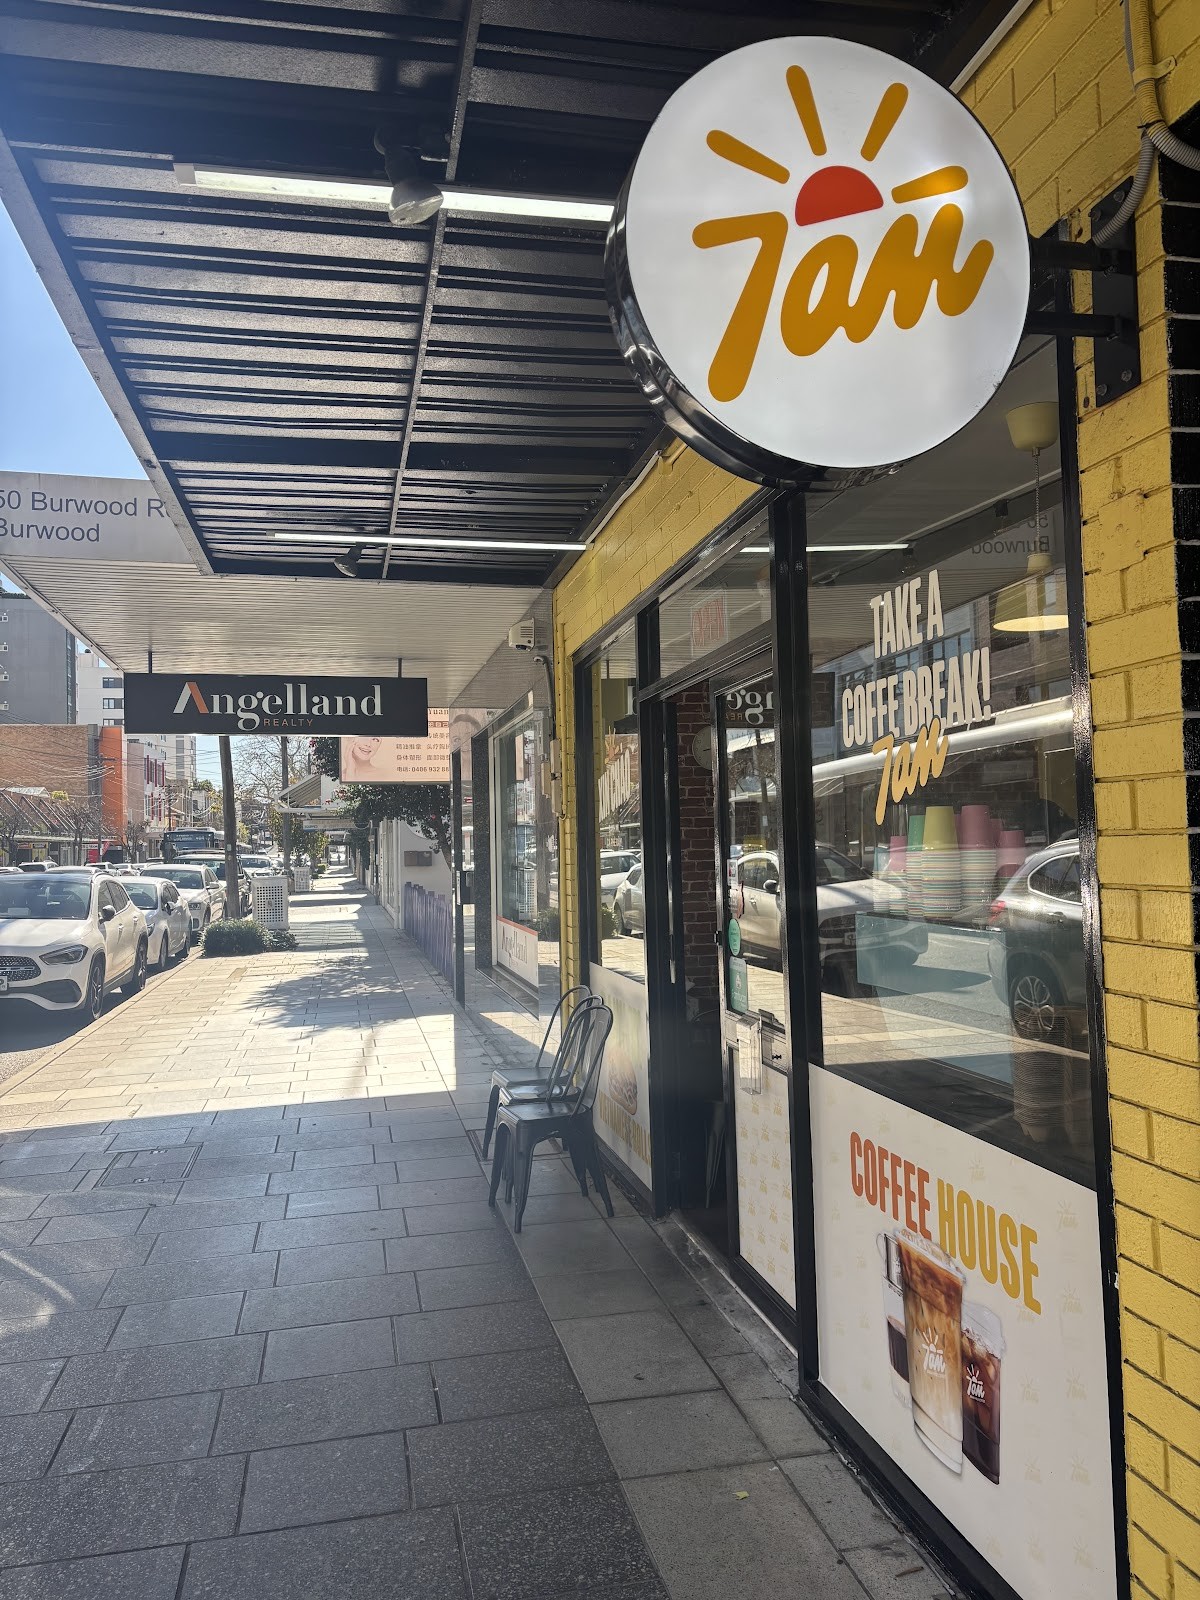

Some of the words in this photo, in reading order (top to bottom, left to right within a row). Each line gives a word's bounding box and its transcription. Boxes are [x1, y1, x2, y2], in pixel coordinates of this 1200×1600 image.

[31, 491, 137, 517] Burwood
[147, 498, 171, 518] R
[870, 577, 923, 659] TAKE
[927, 569, 944, 641] A
[173, 682, 384, 731] Angelland
[263, 718, 314, 727] REALTY
[842, 672, 900, 748] COFFE
[903, 646, 992, 736] BREAK!
[850, 1131, 932, 1242] COFFEE
[937, 1177, 1042, 1315] HOUSE
